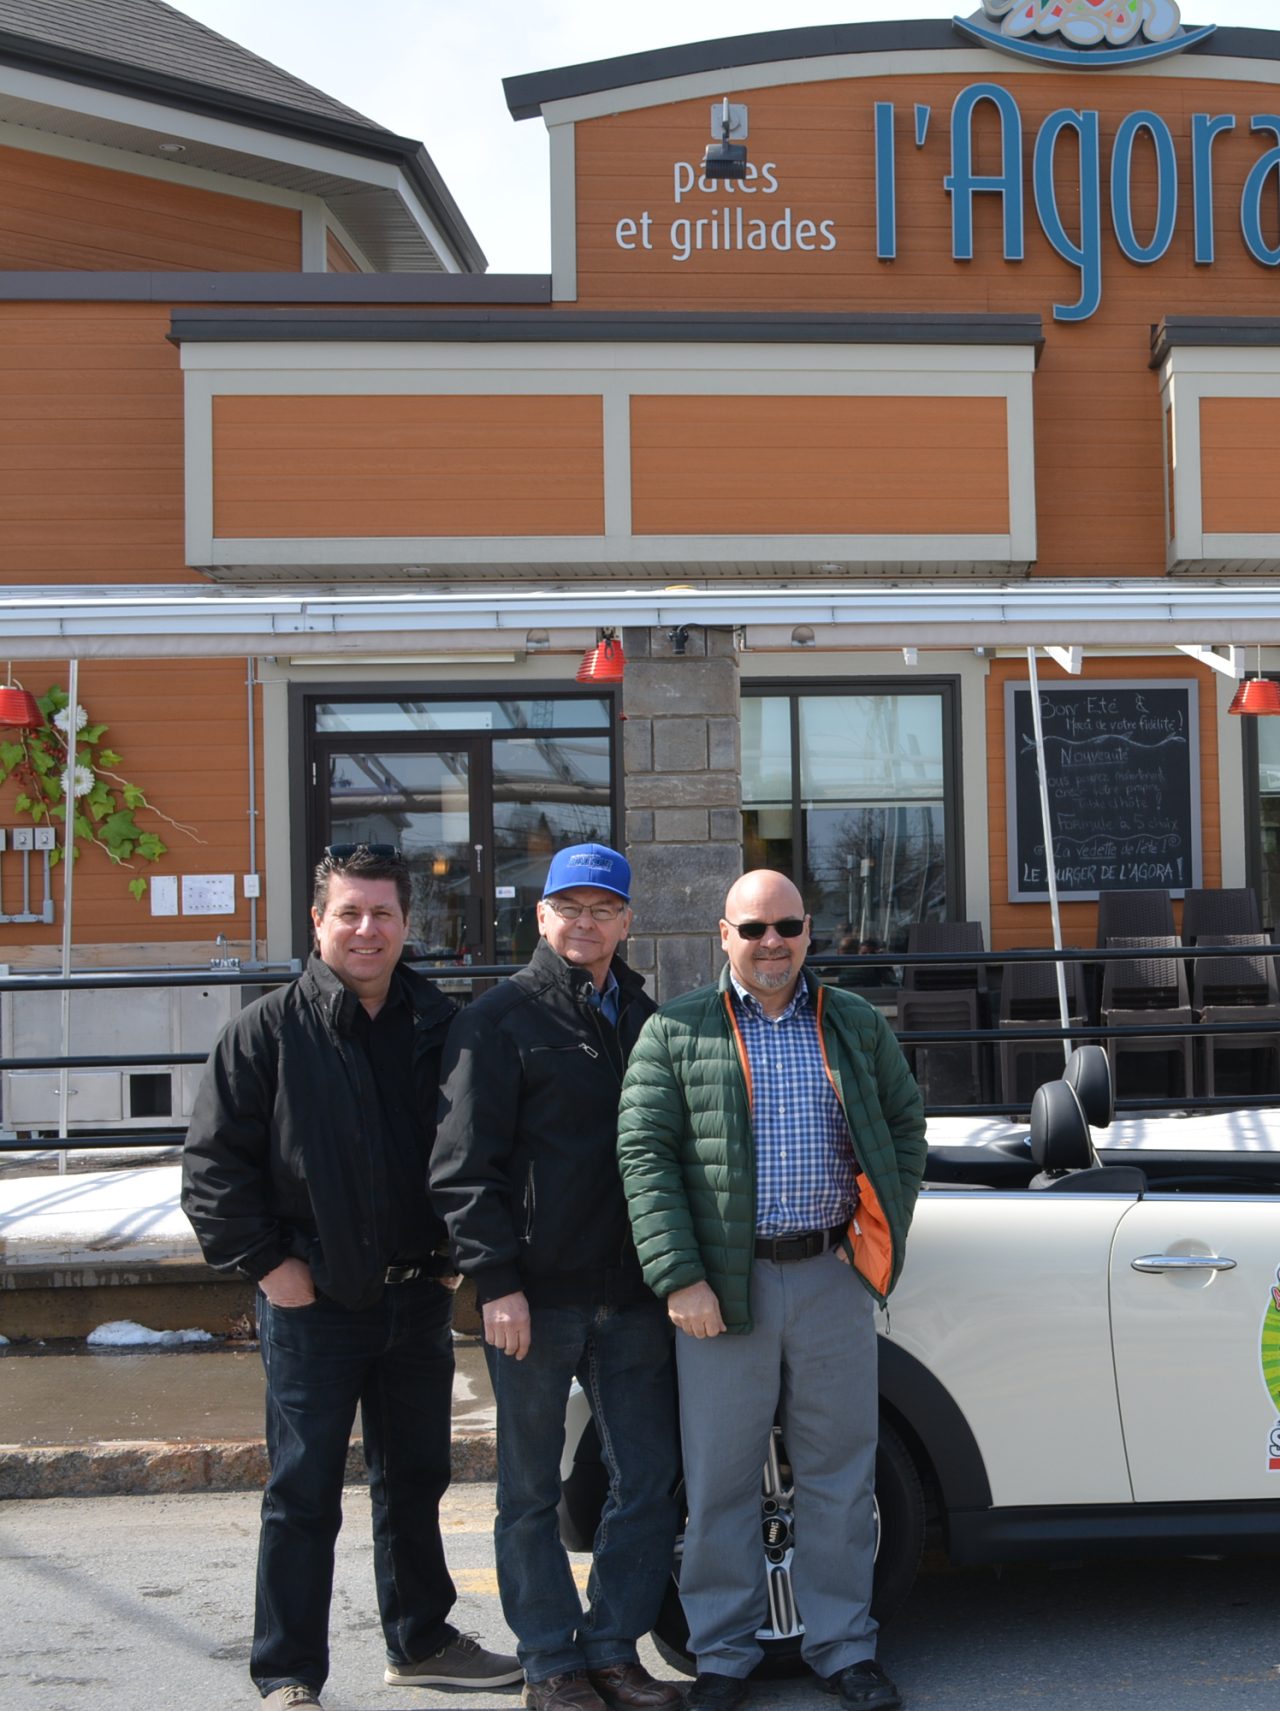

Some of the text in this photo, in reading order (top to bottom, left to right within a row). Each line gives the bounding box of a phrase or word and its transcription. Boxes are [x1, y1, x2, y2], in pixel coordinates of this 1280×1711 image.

[615, 207, 837, 261] et grillades
[1110, 718, 1136, 730] votre
[1036, 769, 1070, 788] ous
[1053, 842, 1071, 858] La
[1077, 839, 1117, 857] vedette
[1023, 863, 1041, 882] LE
[1045, 864, 1097, 887] URGER
[1101, 865, 1117, 880] DE
[1120, 862, 1173, 882] L'AGORA
